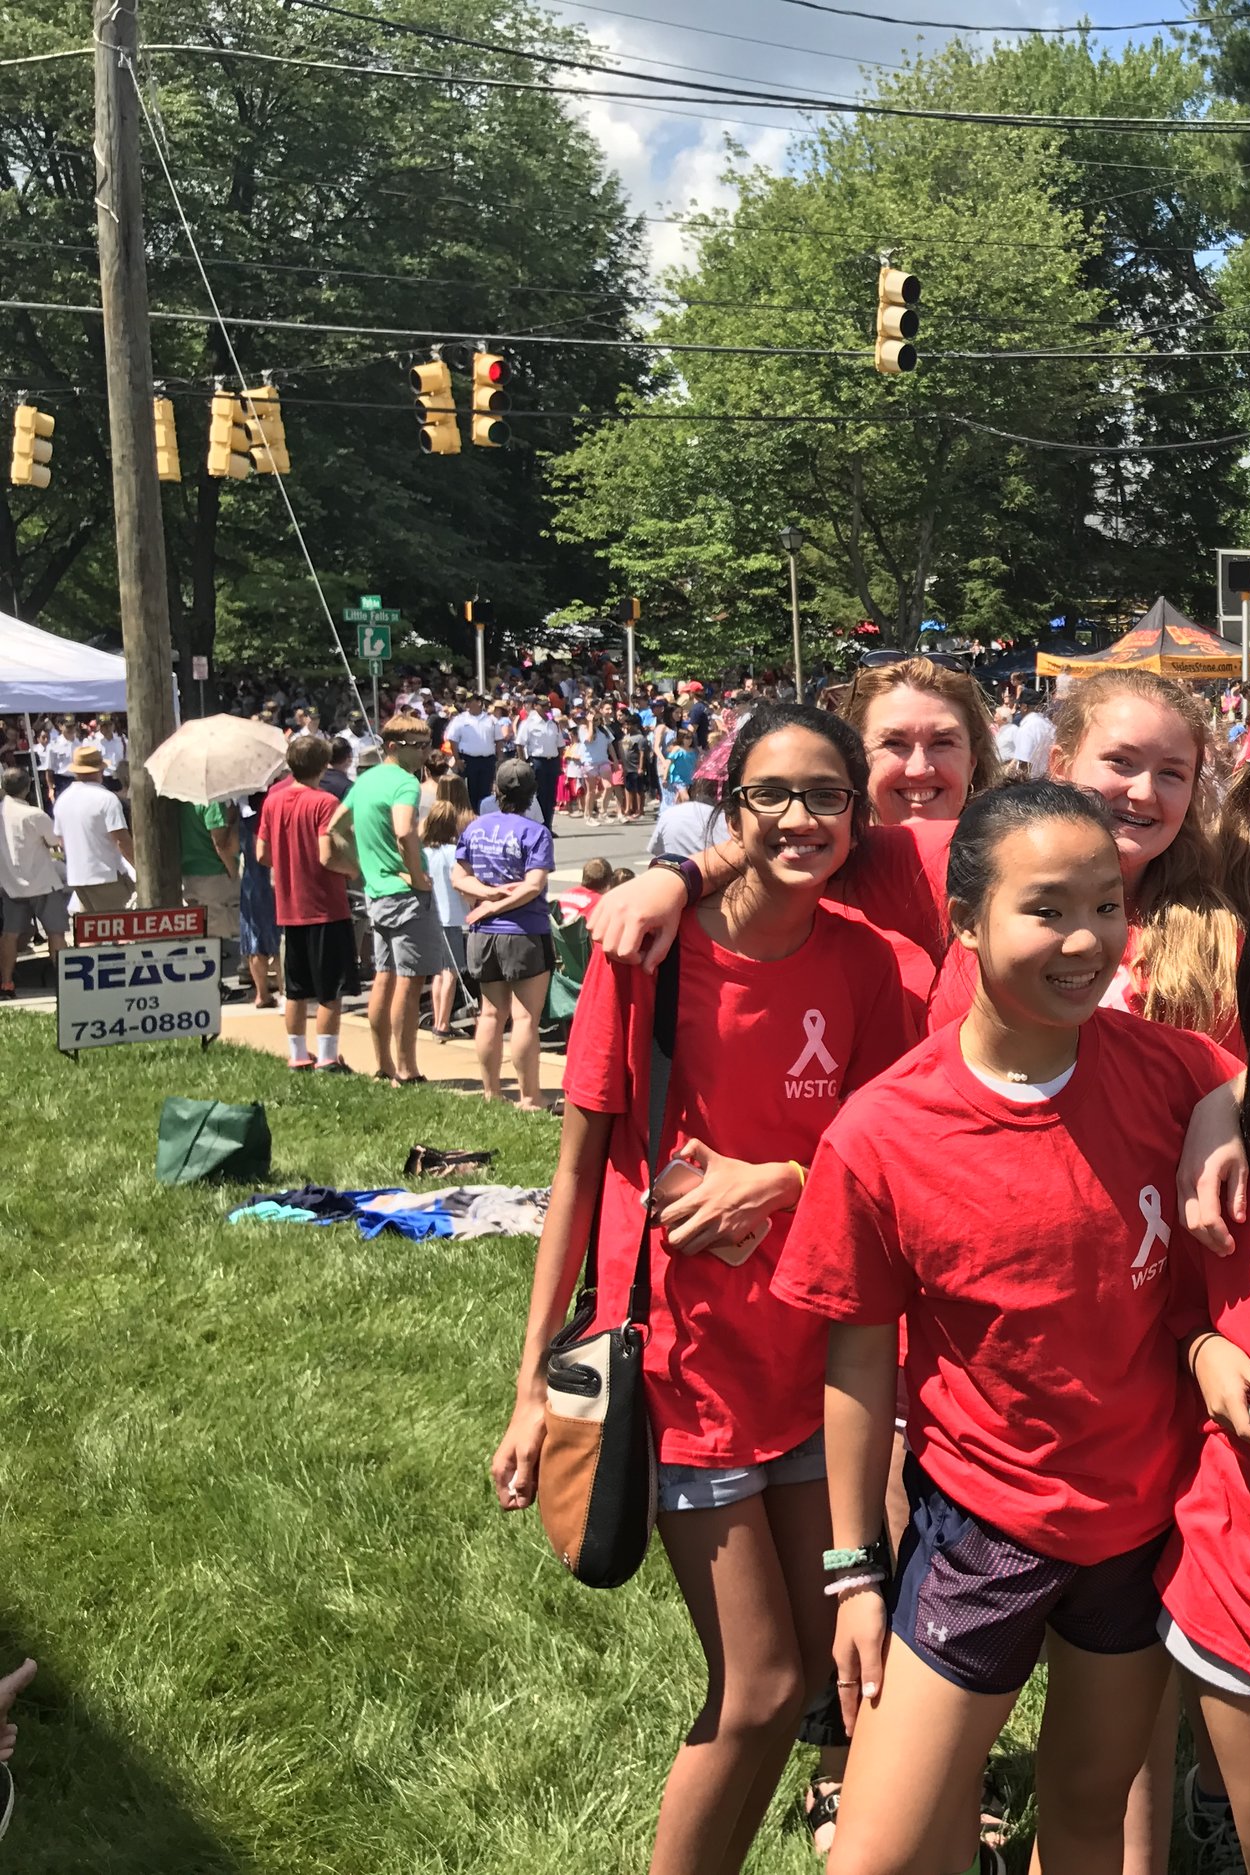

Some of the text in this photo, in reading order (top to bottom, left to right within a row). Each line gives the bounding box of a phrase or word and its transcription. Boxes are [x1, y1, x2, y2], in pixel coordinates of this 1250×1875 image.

[345, 610, 367, 620] Little
[371, 611, 389, 621] Falls
[84, 913, 198, 938] FOR LEASE
[125, 996, 160, 1012] 703
[72, 1010, 210, 1041] 734-0880
[1131, 1255, 1168, 1290] WST
